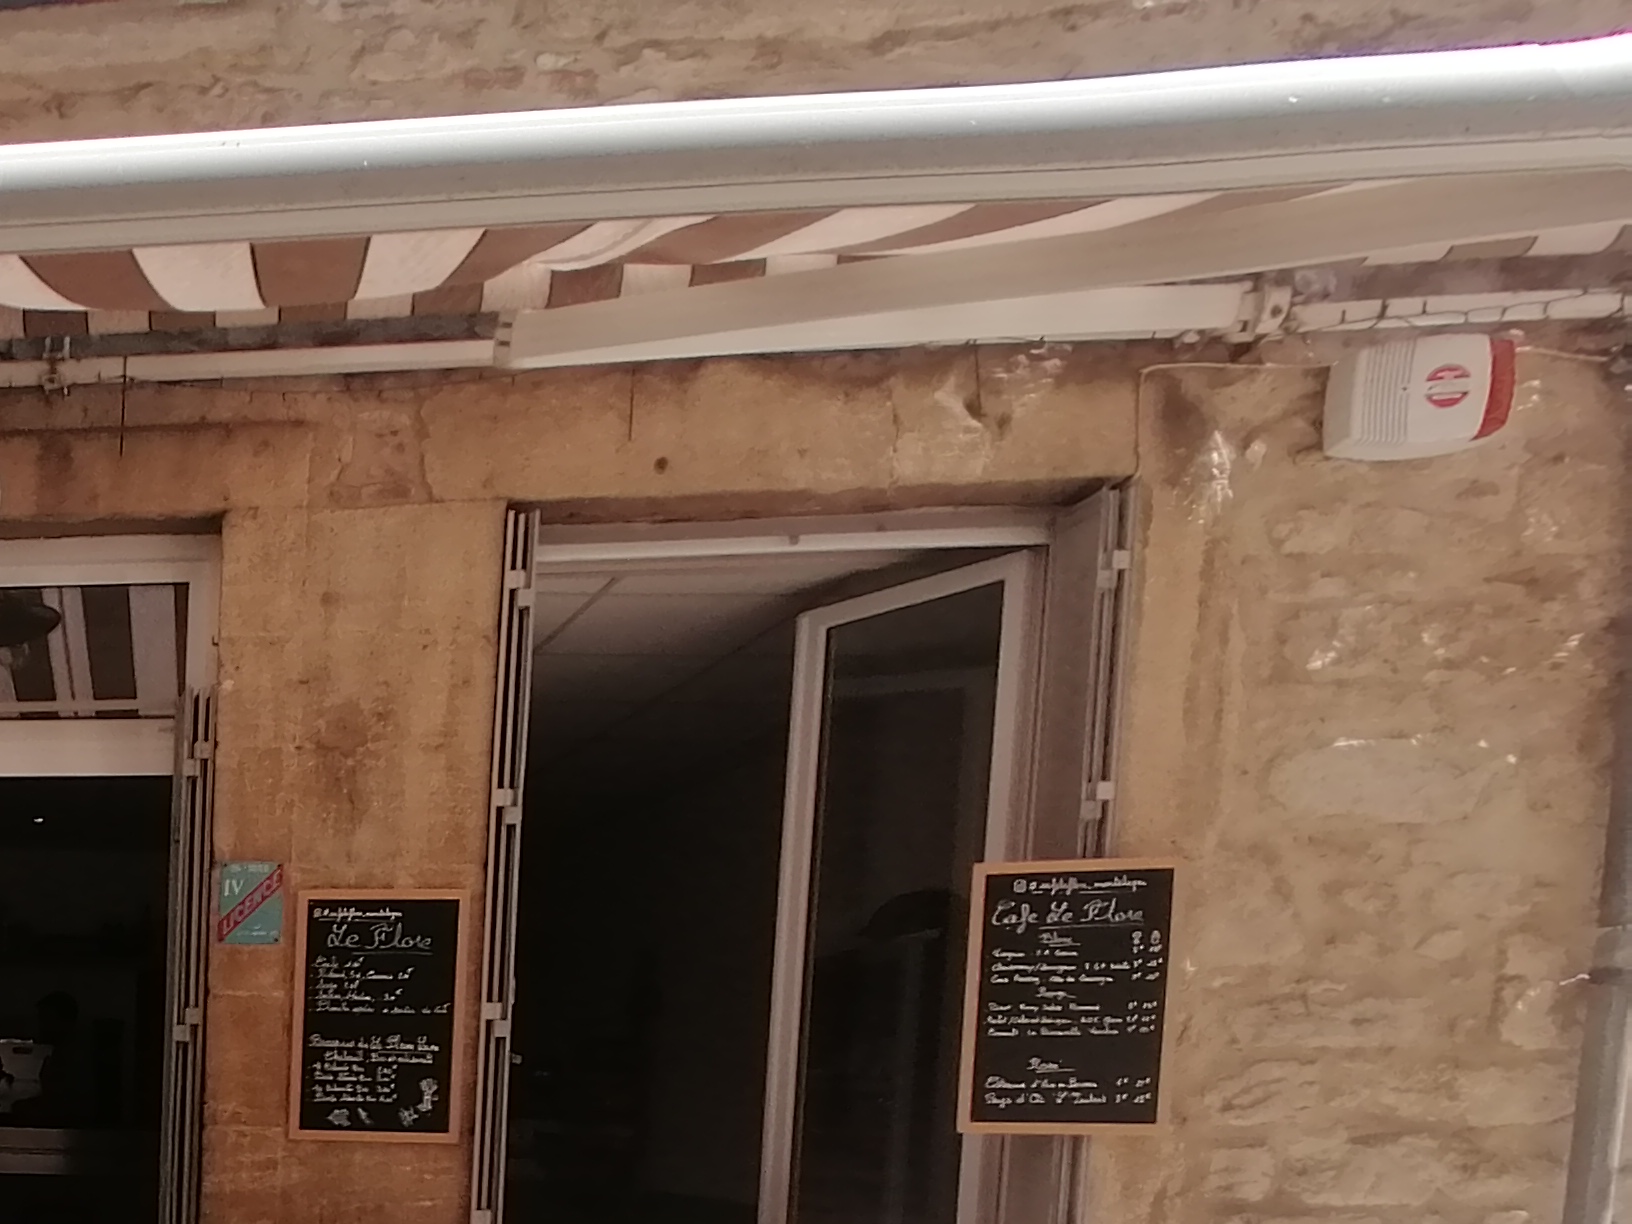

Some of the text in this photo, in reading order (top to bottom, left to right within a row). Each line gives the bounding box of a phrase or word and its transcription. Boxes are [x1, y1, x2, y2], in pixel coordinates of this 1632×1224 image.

[223, 878, 244, 897] IV
[222, 868, 282, 935] LICENCE
[1080, 898, 1145, 924] Flore
[326, 921, 434, 950] Le Flore
